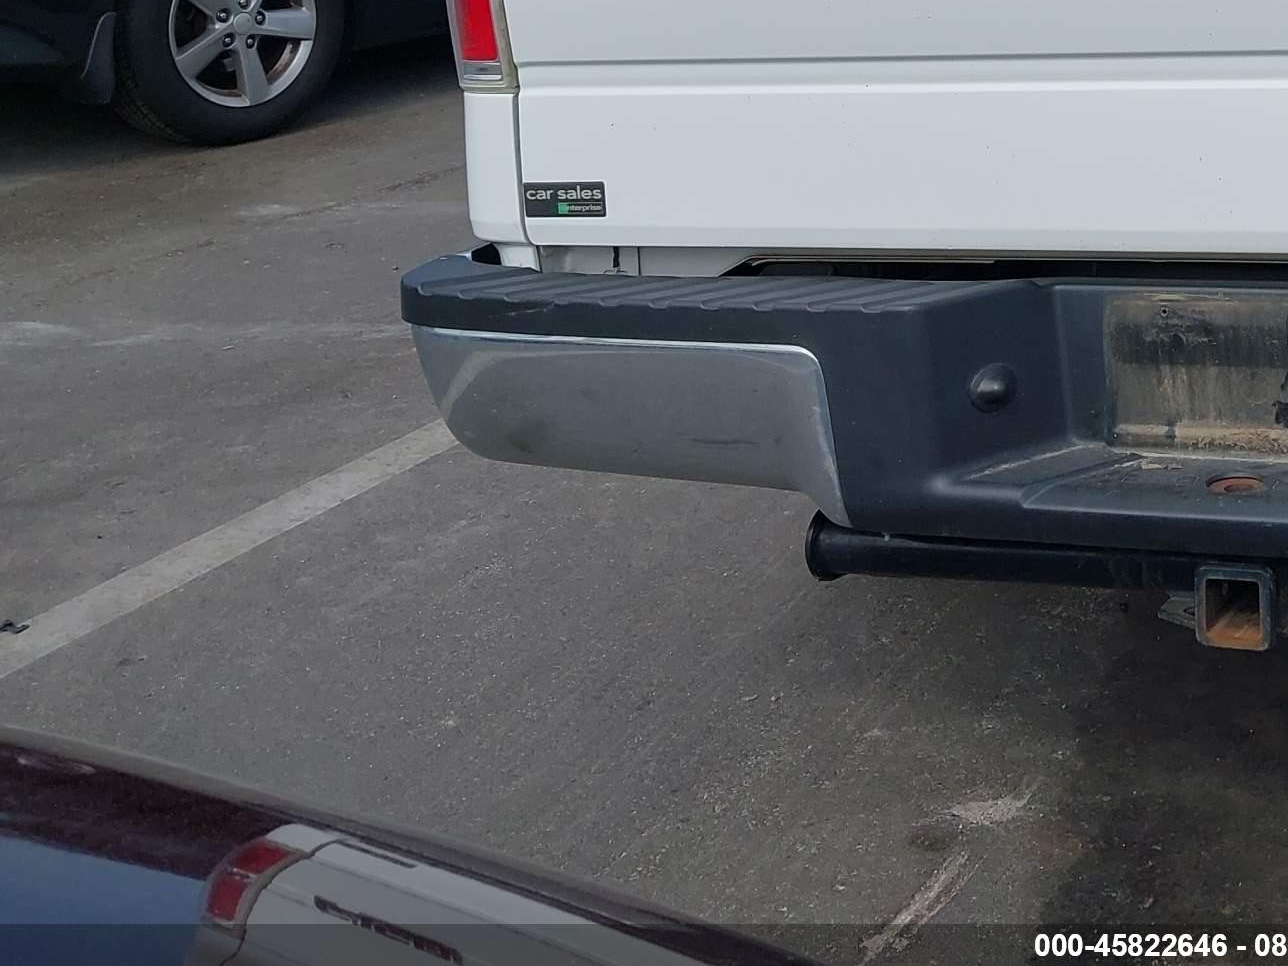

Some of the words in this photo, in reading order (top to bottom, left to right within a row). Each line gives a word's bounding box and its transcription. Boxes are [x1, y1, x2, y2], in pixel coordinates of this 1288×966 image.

[526, 189, 553, 200] car
[557, 185, 602, 200] sales
[559, 203, 602, 212] nterprise
